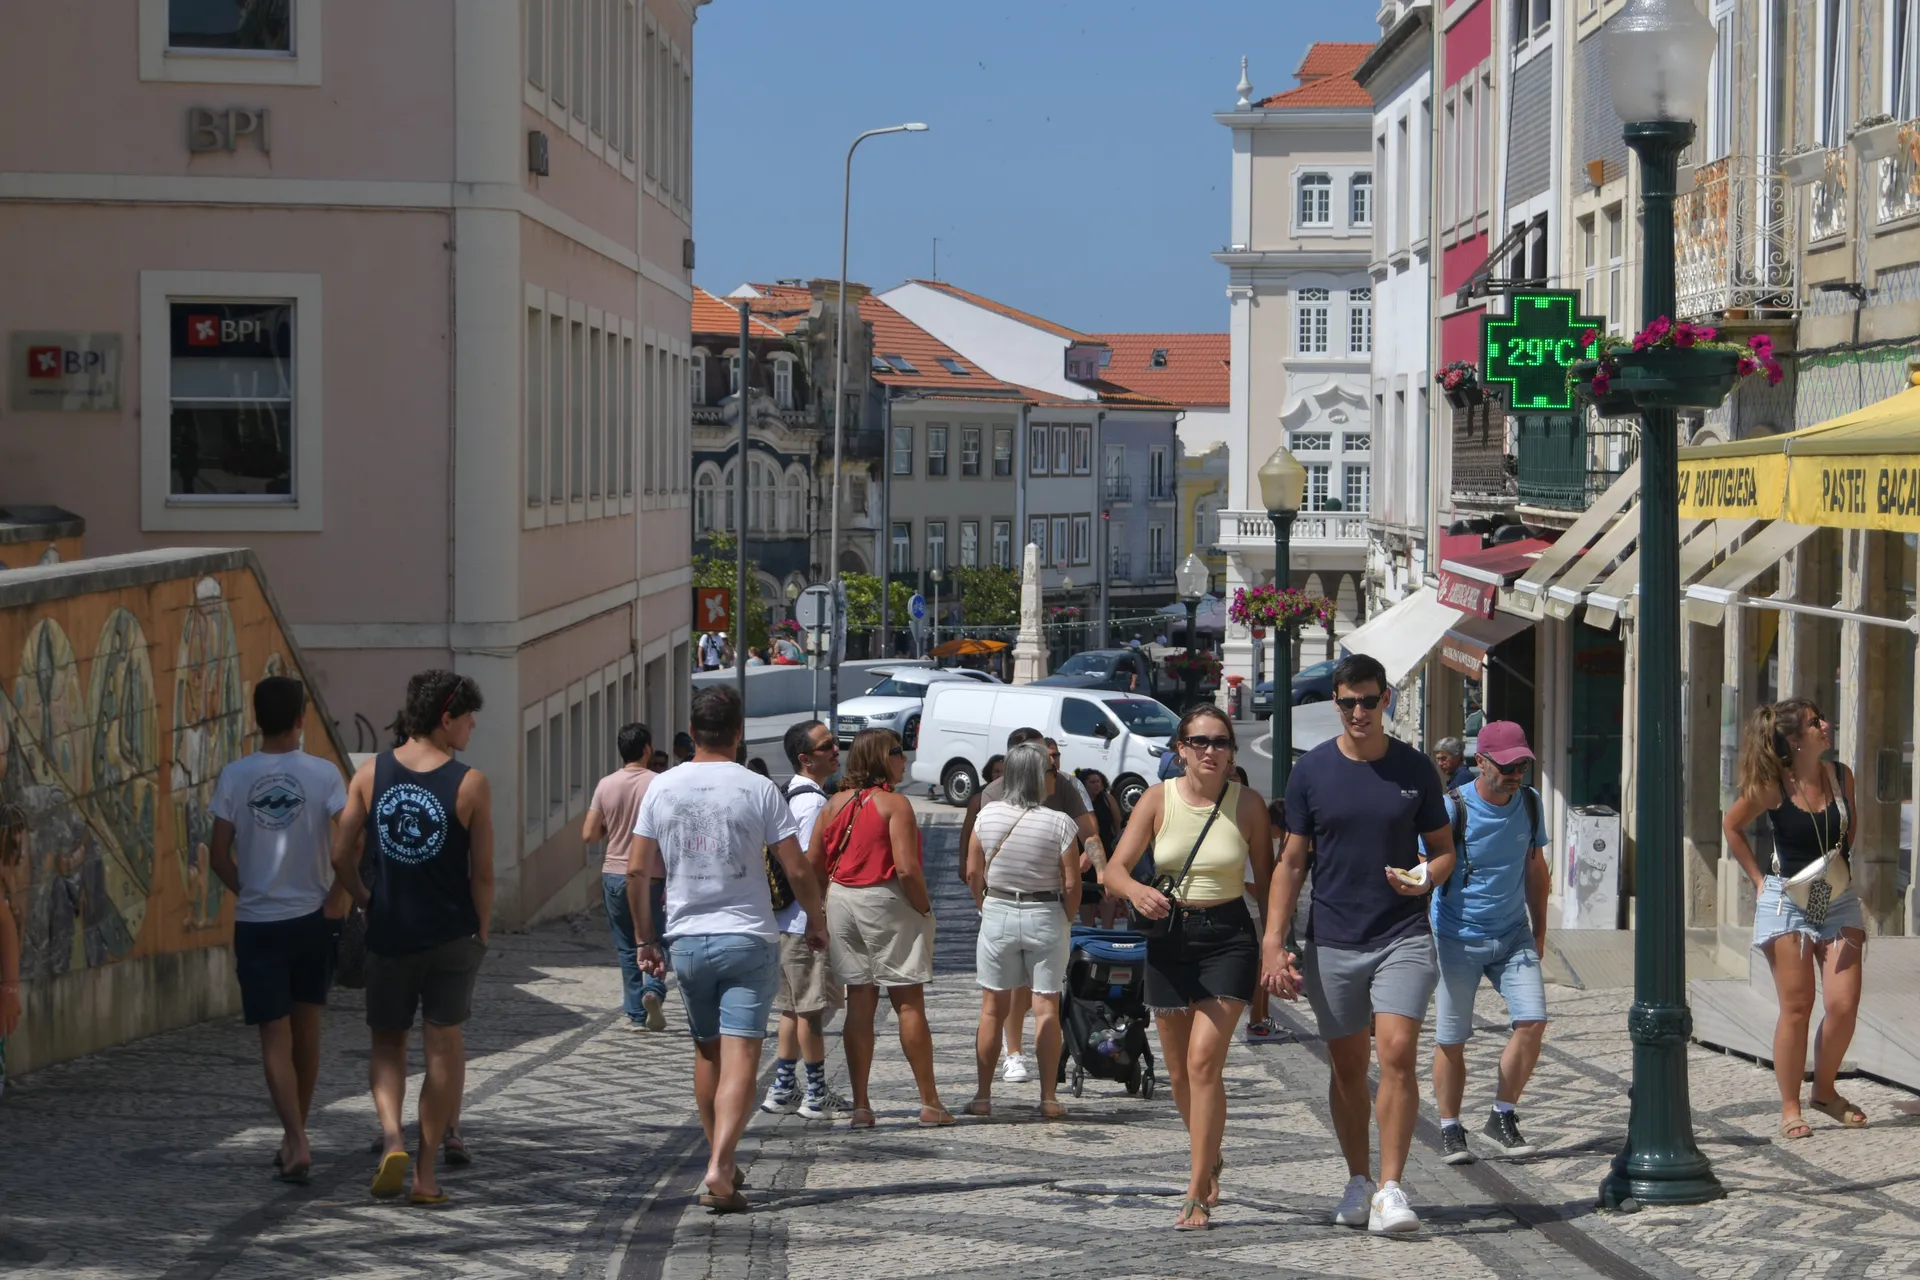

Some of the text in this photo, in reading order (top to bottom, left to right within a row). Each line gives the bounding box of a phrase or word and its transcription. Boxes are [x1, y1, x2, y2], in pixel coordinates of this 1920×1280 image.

[188, 107, 271, 151] BPI
[221, 320, 260, 343] BPI
[64, 350, 105, 374] BPI
[1822, 468, 1866, 513] PASTEL
[382, 790, 439, 822] Quiksilver
